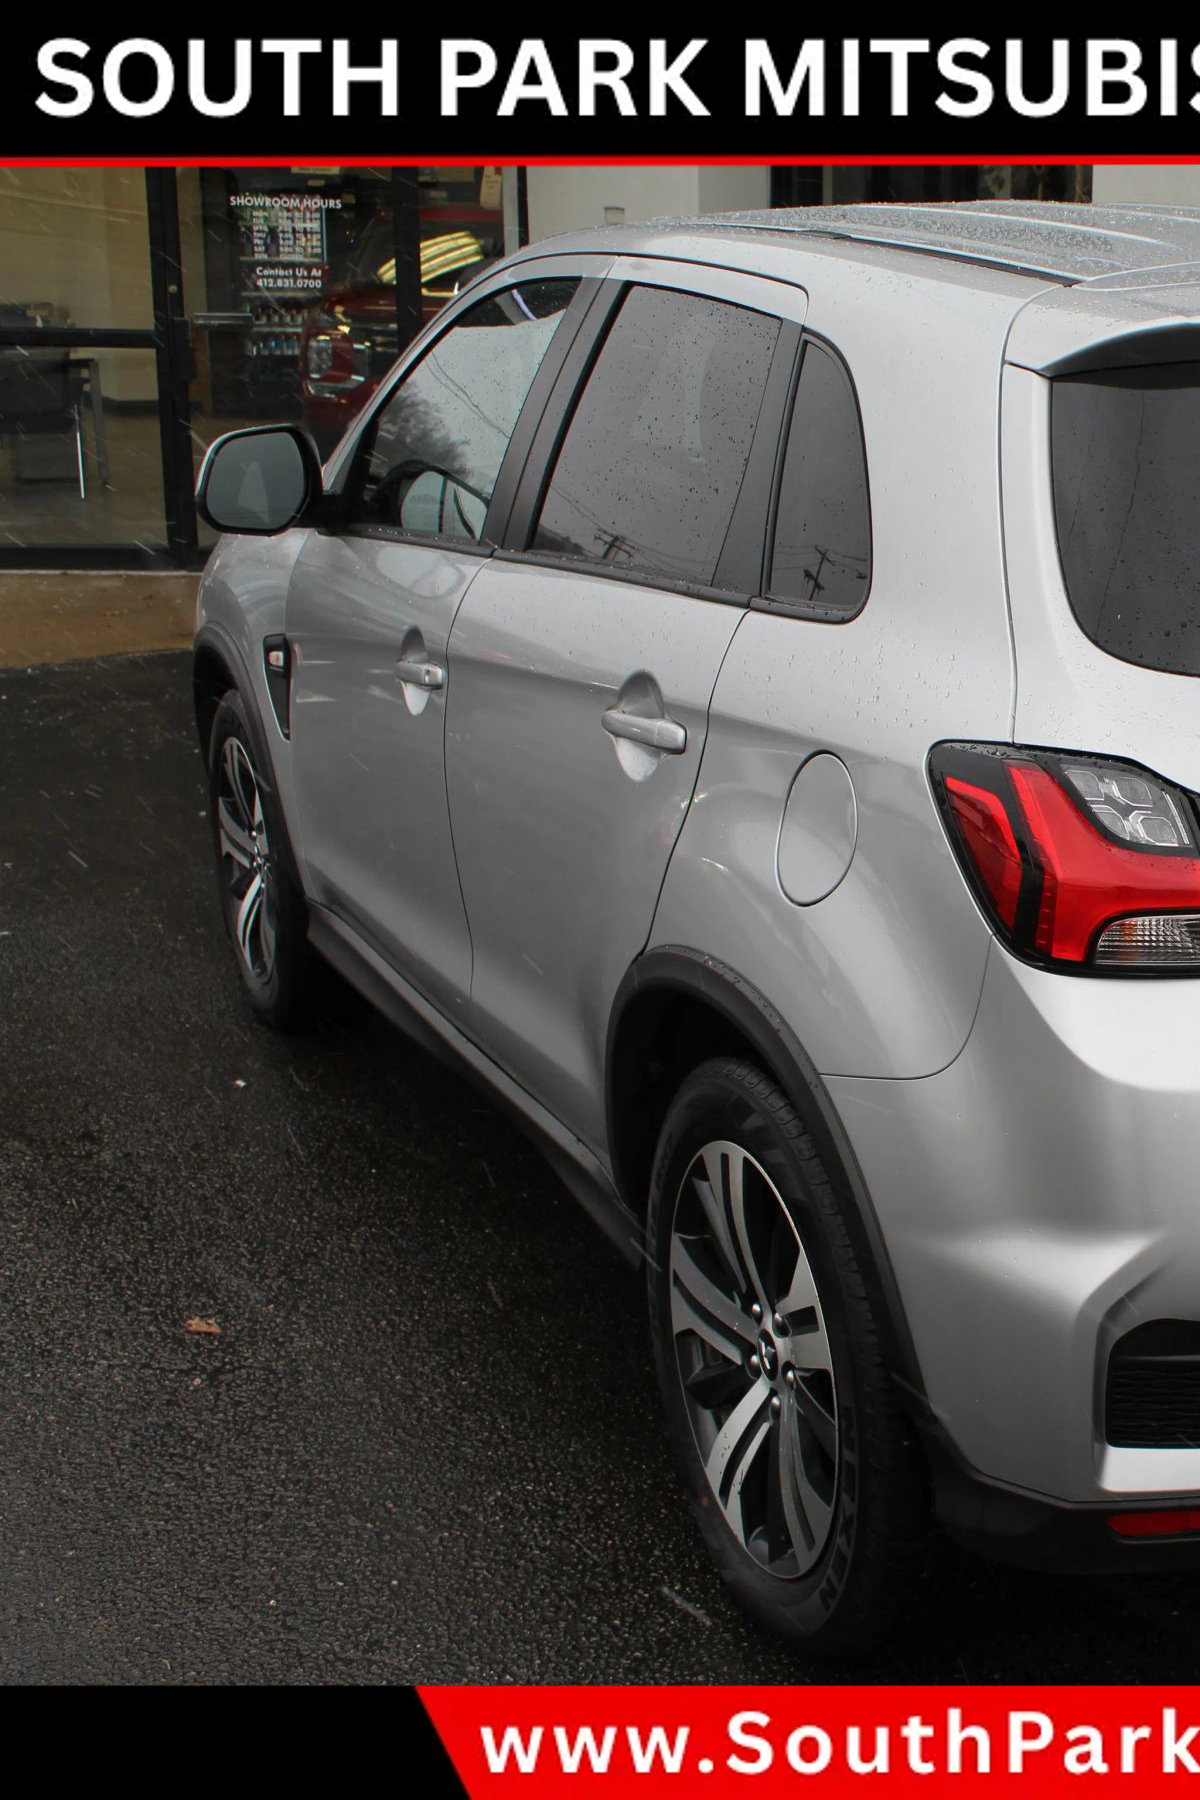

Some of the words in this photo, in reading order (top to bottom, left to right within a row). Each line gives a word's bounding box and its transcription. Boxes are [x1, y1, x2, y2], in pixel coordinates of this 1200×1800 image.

[230, 196, 300, 208] SHOWROOM
[303, 198, 342, 209] HOURS
[256, 267, 293, 276] Contact
[295, 268, 307, 277] Us
[310, 268, 322, 277] At
[256, 279, 322, 288] 412.831.0700
